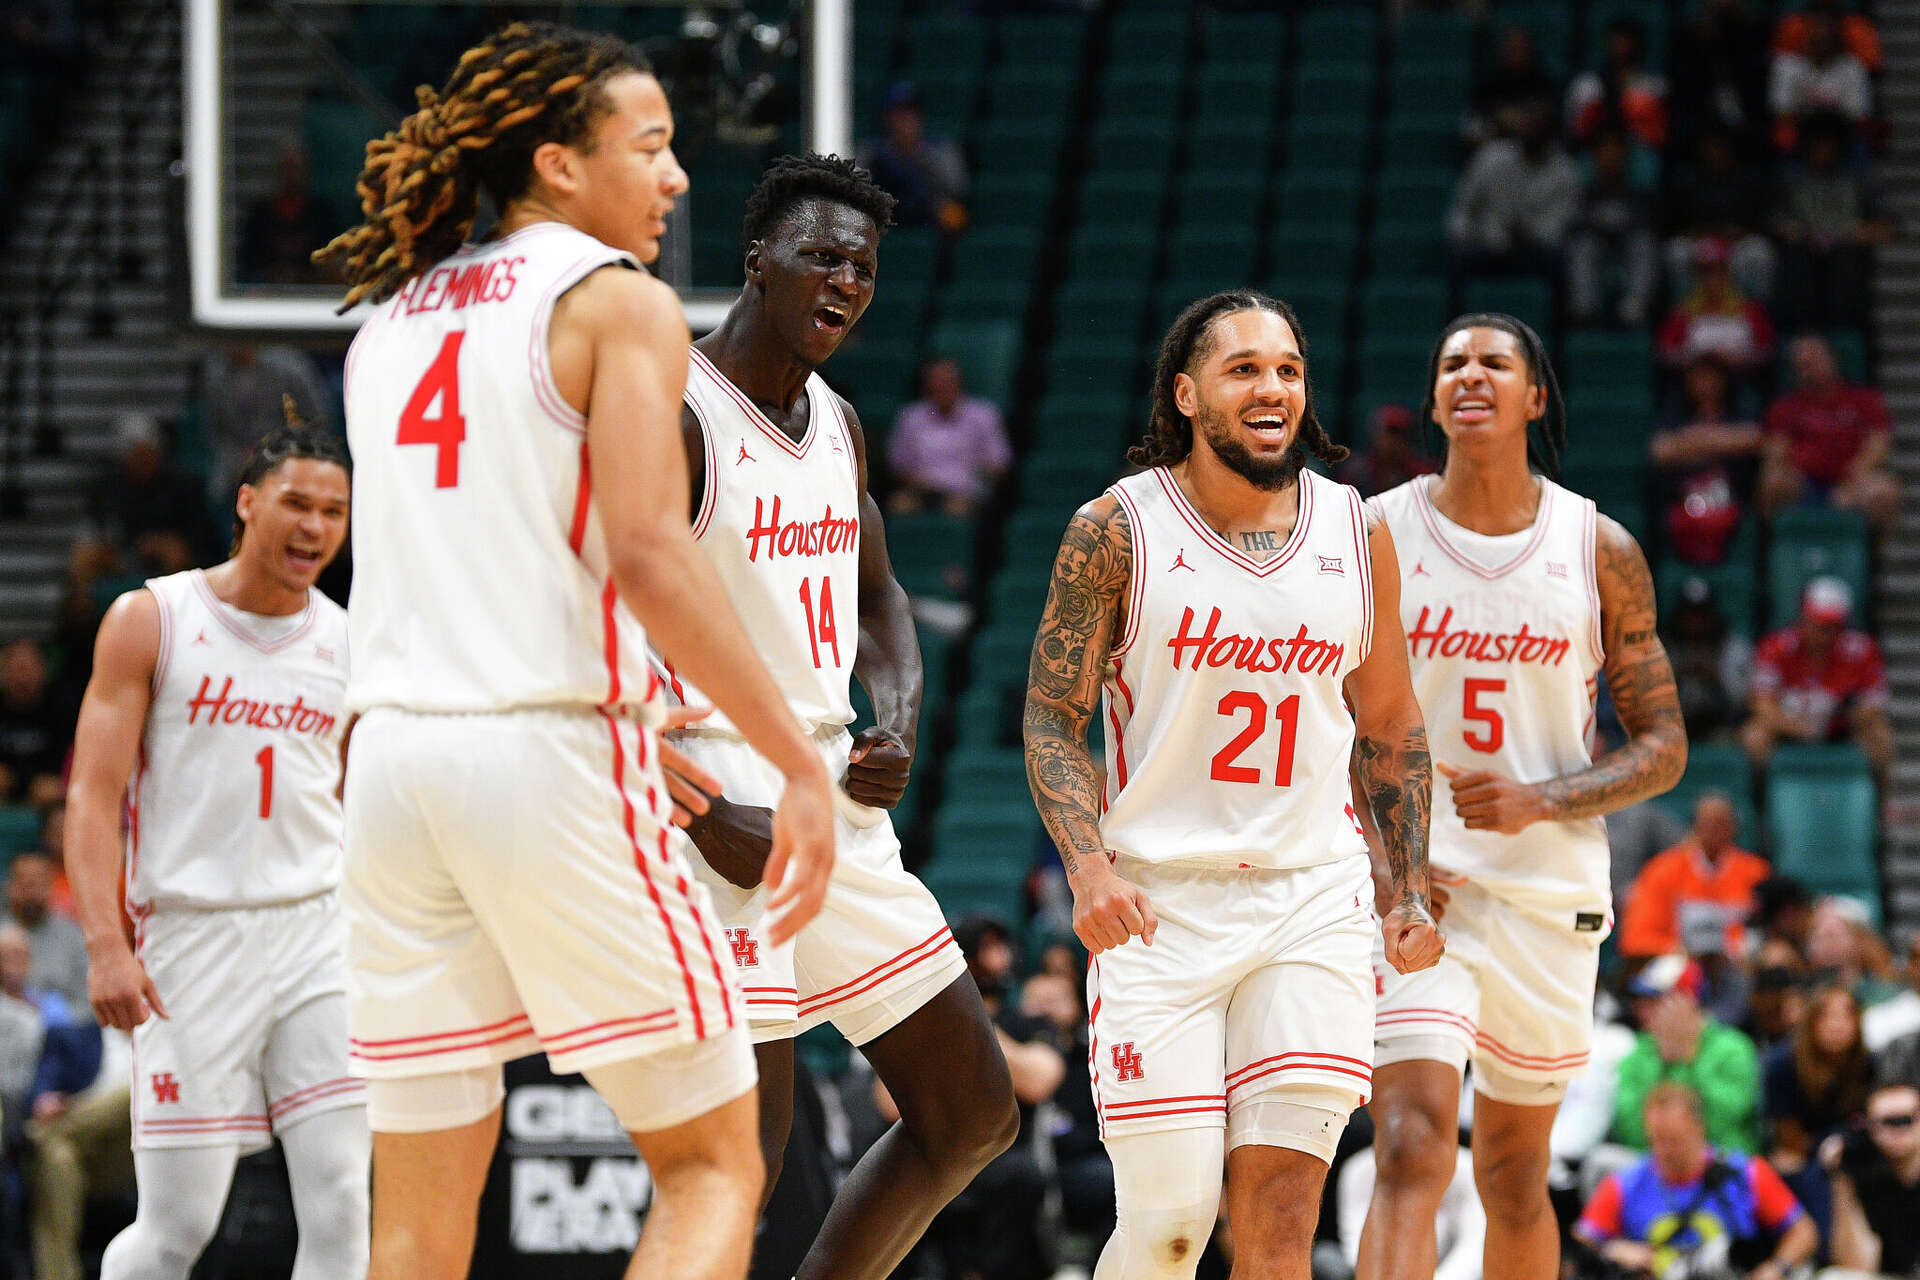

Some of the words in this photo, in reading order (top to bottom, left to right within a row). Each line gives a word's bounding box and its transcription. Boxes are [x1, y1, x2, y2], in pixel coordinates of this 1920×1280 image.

[390, 257, 526, 320] FLEMINGS
[396, 330, 467, 489] 4
[746, 495, 860, 563] Houston
[1240, 530, 1280, 552] THE
[799, 575, 841, 669] 14
[1167, 606, 1346, 677] Houston
[1407, 606, 1571, 667] Houston
[188, 676, 337, 737] Houston
[1210, 690, 1300, 788] 21
[1462, 677, 1507, 755] 5
[256, 745, 275, 820] 1
[1111, 1042, 1144, 1081] UH
